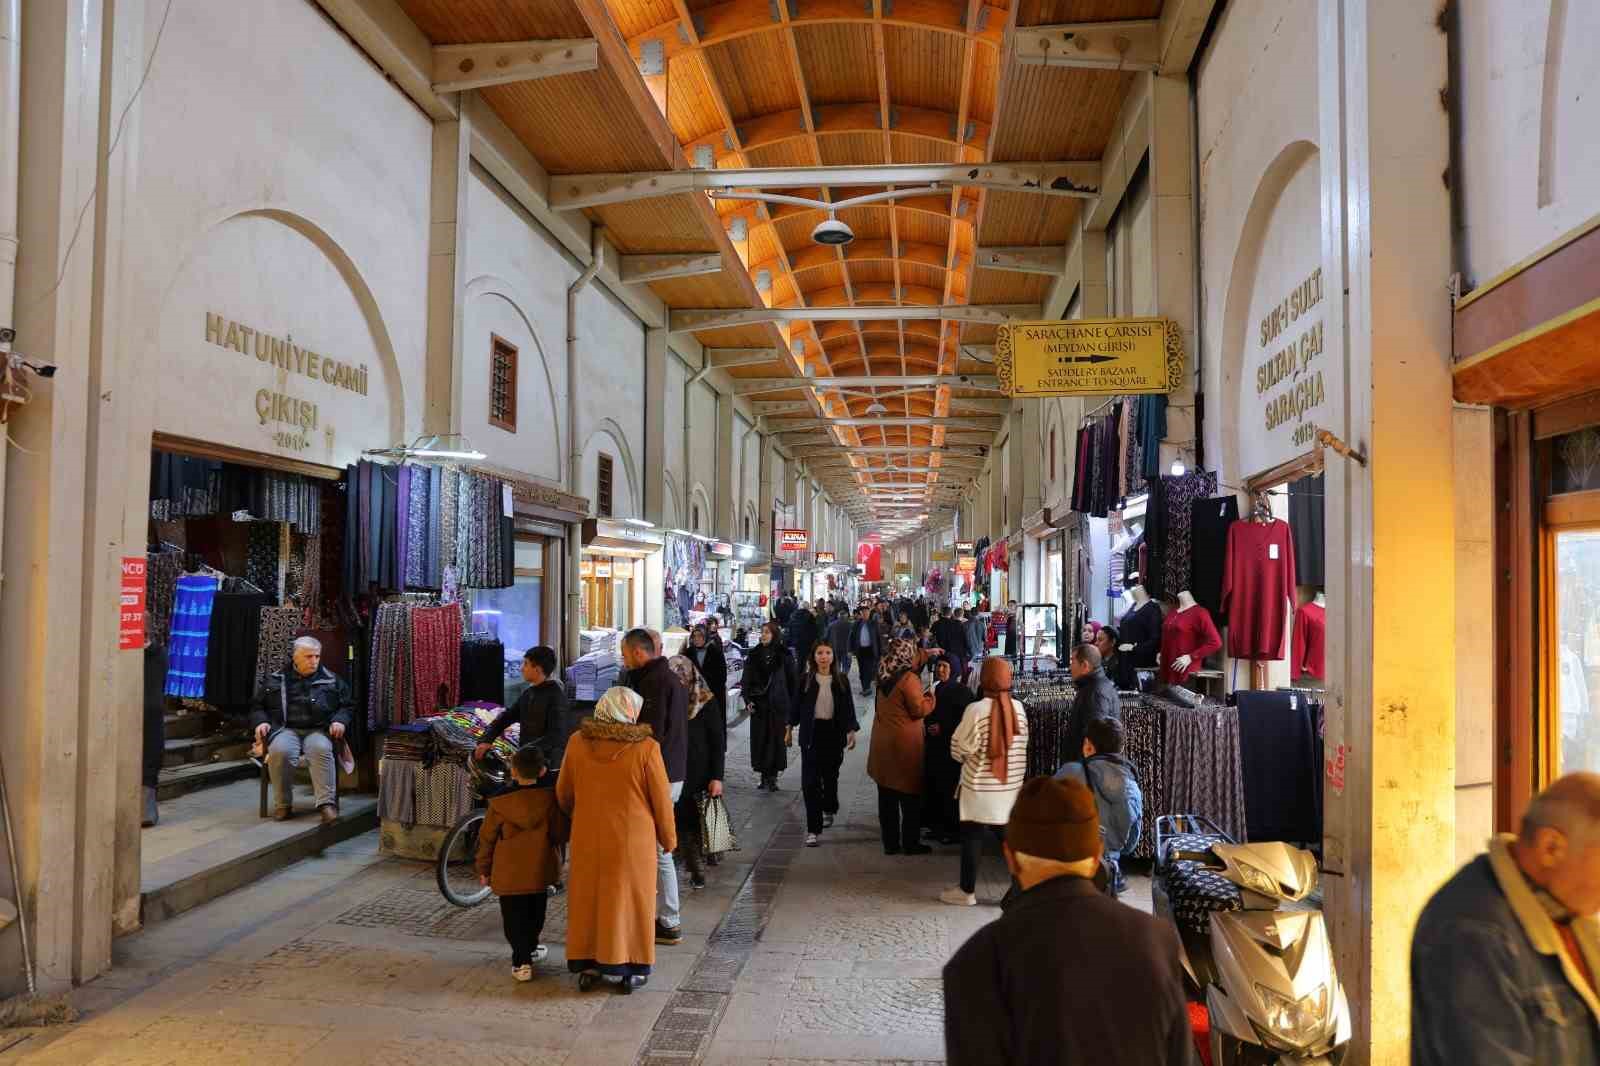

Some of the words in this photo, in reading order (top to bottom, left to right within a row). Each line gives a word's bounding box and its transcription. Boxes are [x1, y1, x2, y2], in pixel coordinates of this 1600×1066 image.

[1047, 367, 1098, 377] SADDLERY
[1100, 366, 1137, 376] BAZAAR
[1256, 341, 1297, 394] SULTAN
[1038, 377, 1091, 387] ENTRANCE
[1093, 376, 1106, 386] TO
[1109, 375, 1149, 386] SQUARE
